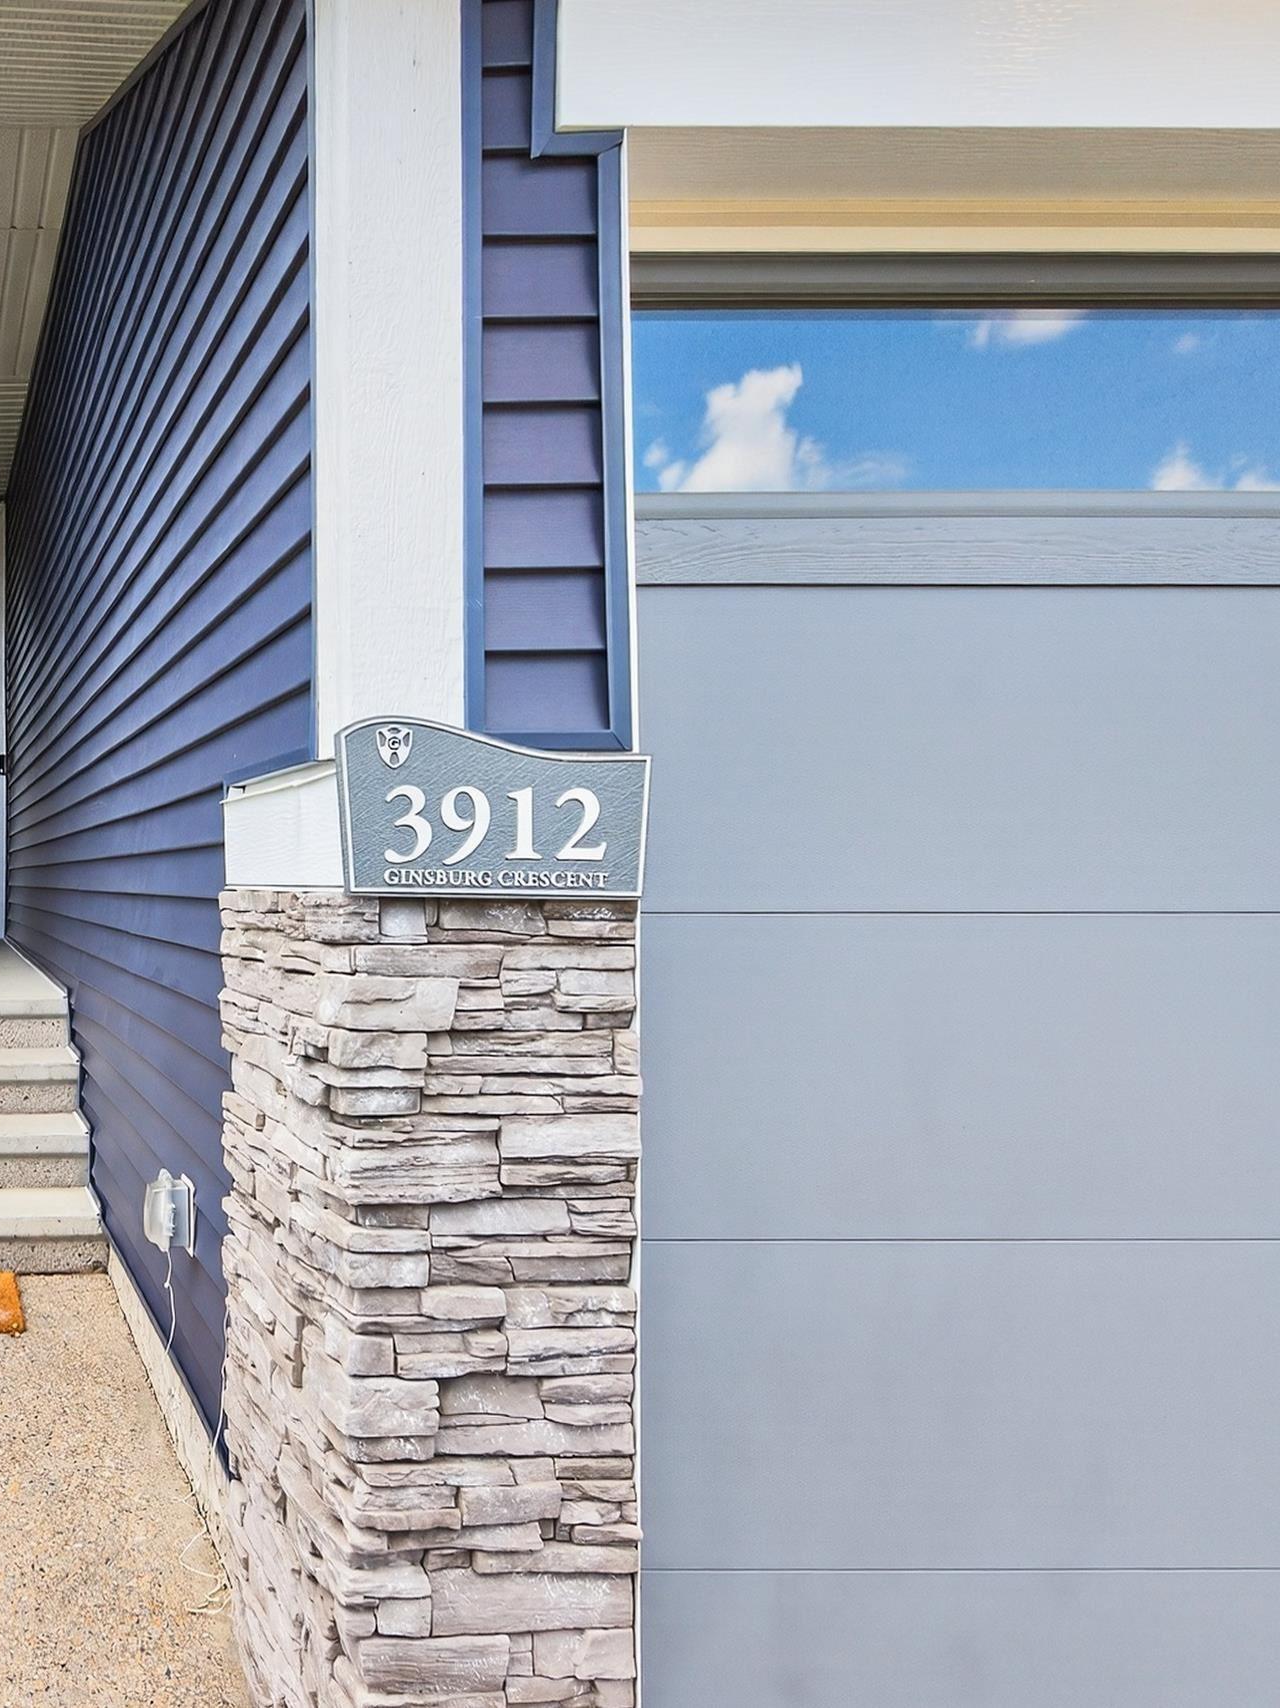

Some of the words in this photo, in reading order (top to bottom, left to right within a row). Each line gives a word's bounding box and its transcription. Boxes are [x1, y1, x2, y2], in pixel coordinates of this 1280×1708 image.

[384, 785, 608, 865] 3912
[384, 868, 492, 886] GINSBURG
[497, 870, 609, 888] CRESCENT
